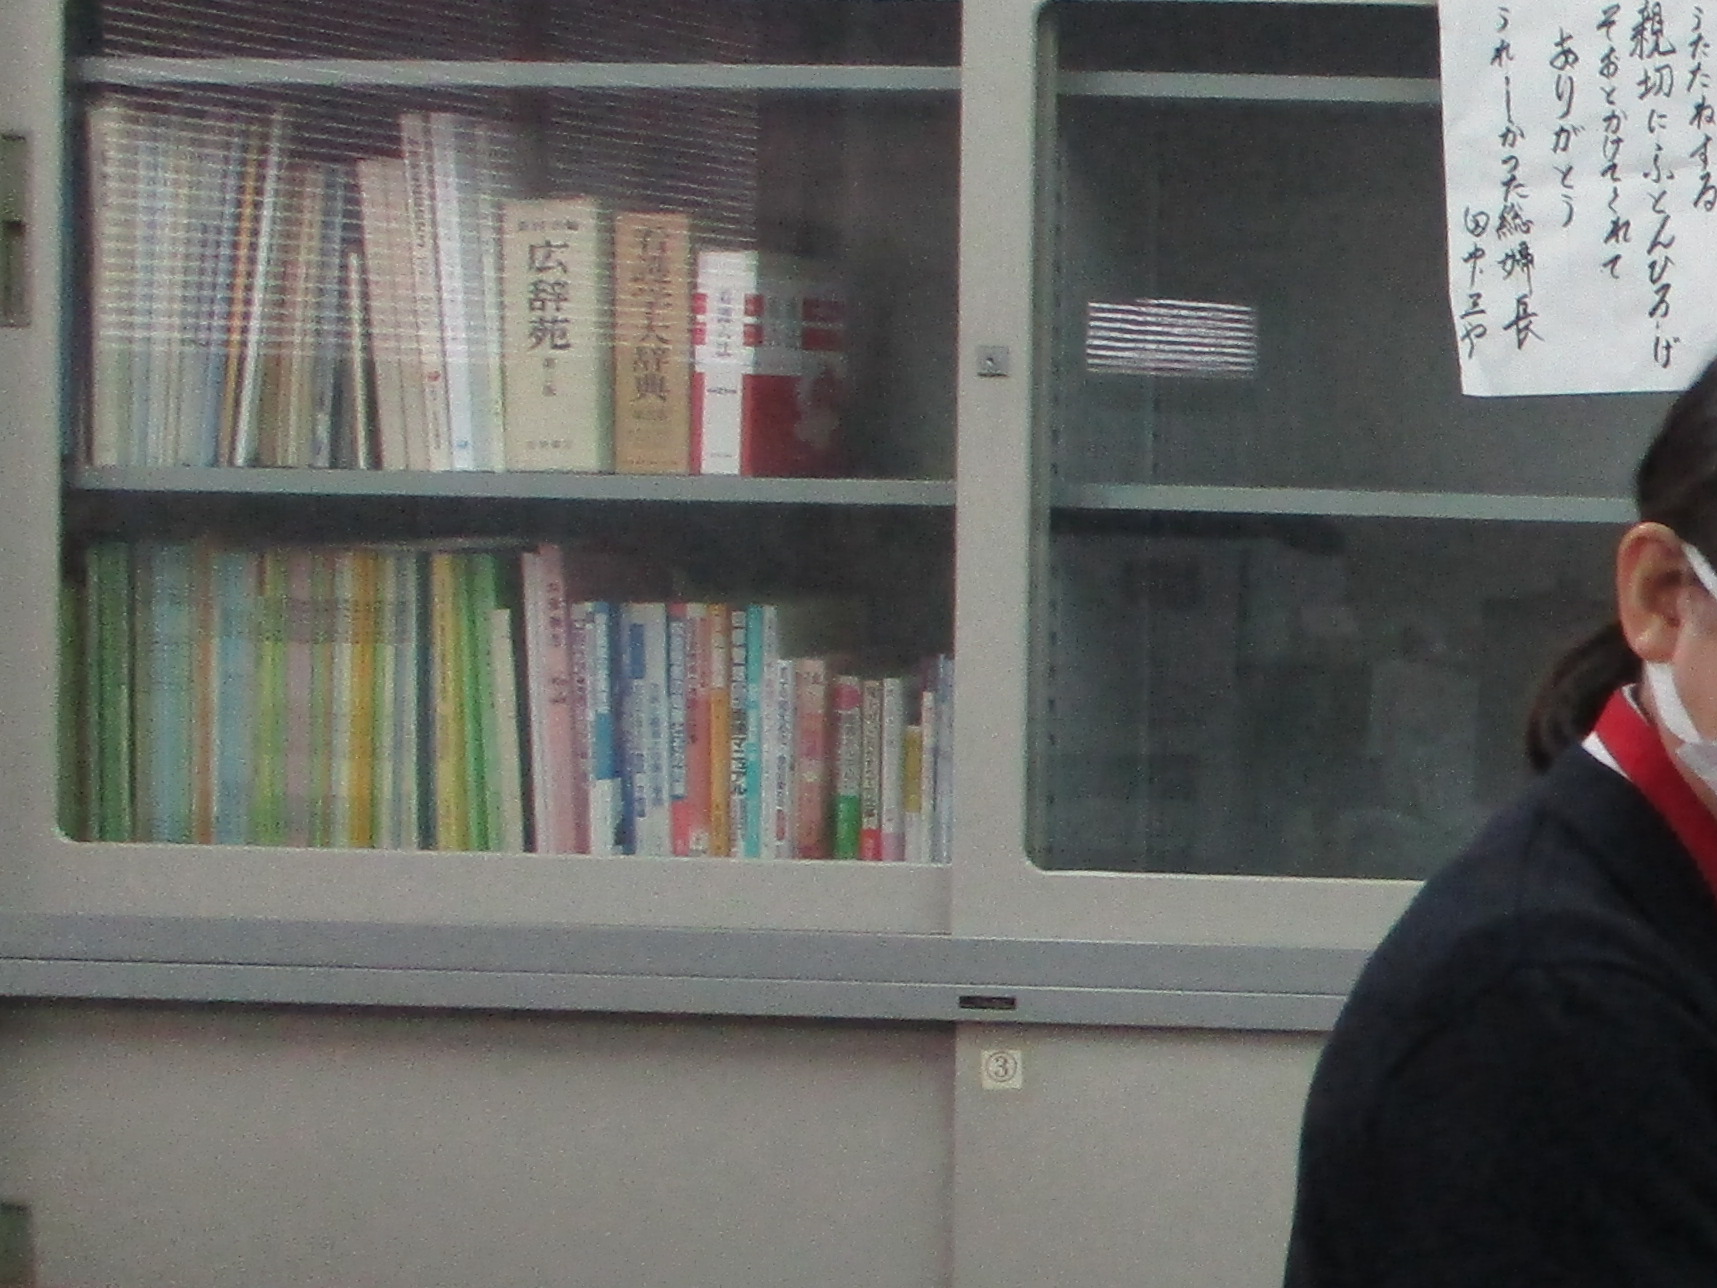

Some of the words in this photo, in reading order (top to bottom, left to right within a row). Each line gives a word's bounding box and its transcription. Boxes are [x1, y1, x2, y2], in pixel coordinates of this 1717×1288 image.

[1549, 26, 1586, 228] ありがとう
[527, 239, 572, 350] 広辞苑
